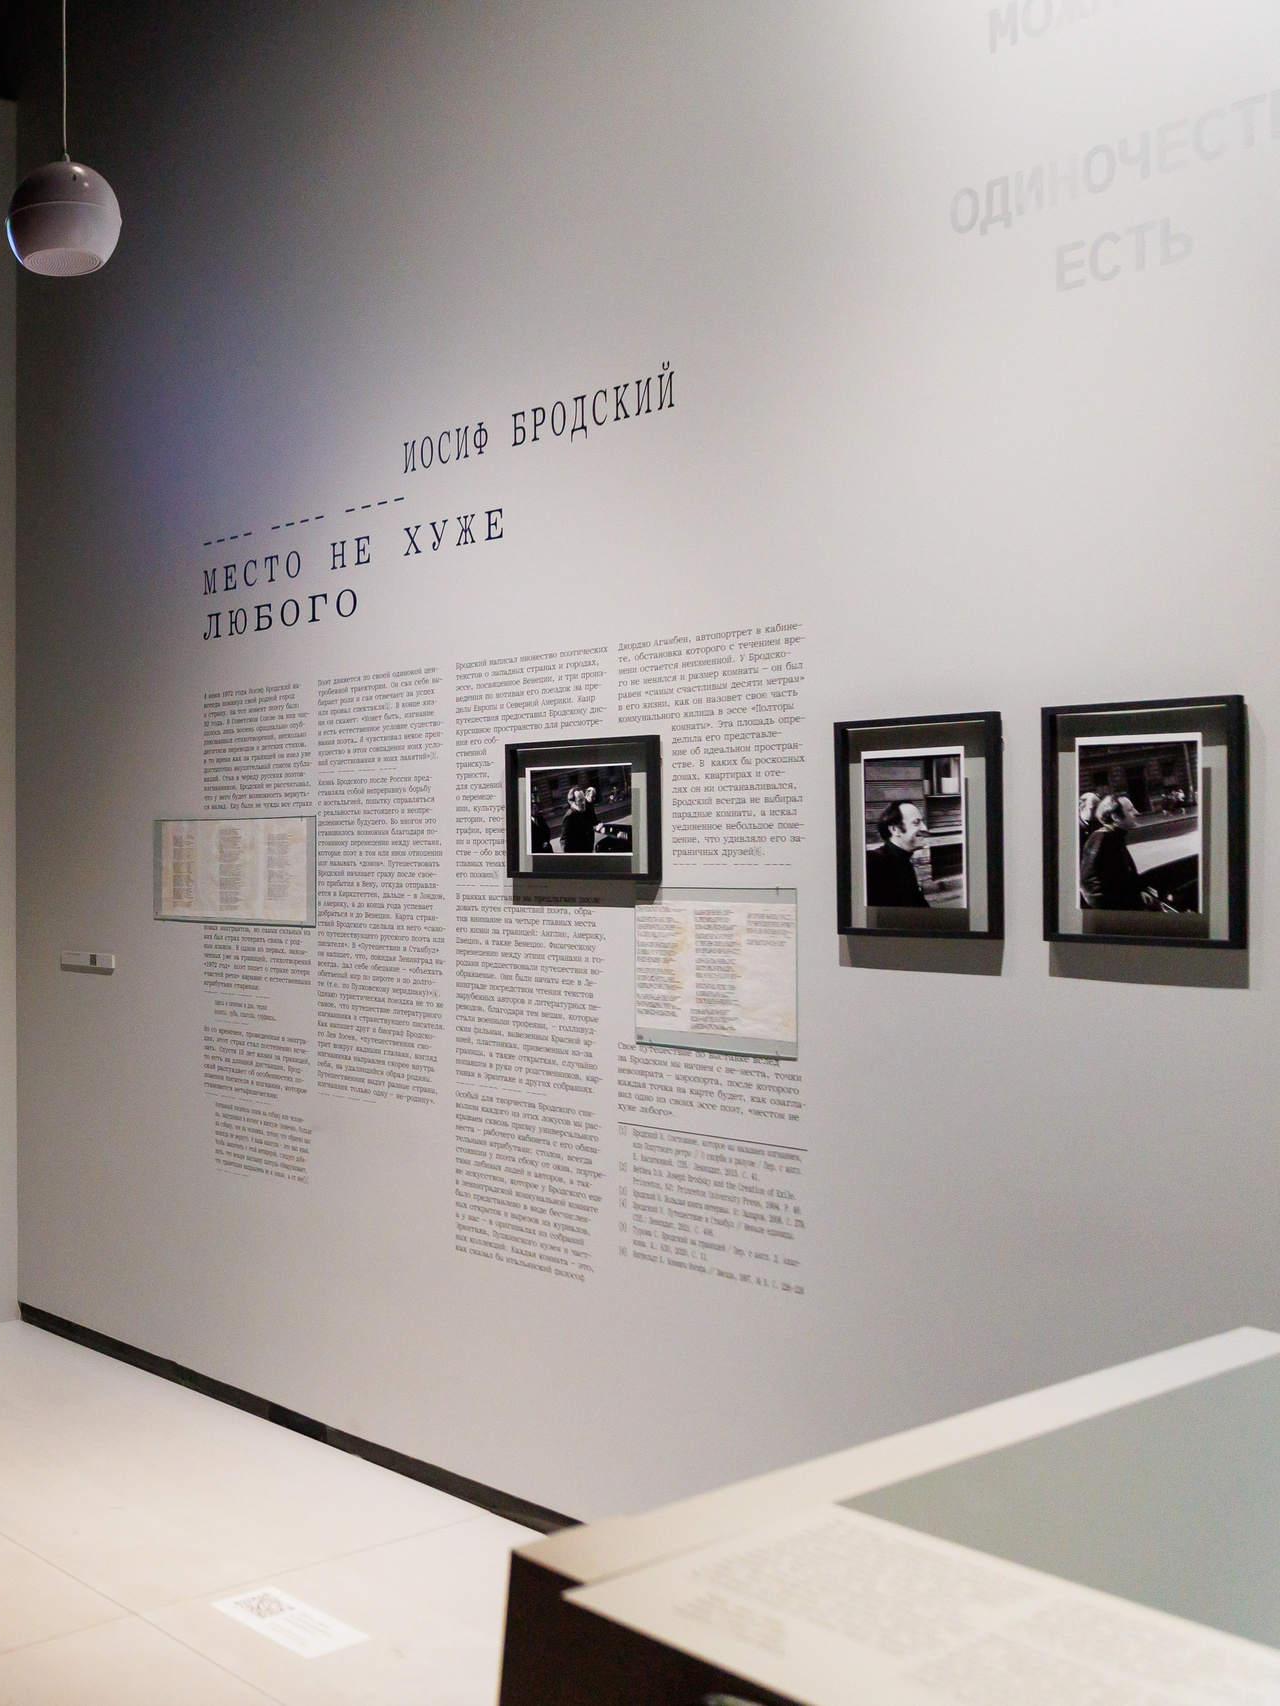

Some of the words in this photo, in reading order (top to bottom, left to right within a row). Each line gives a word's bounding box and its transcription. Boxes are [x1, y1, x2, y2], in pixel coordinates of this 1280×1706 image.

[1056, 217, 1194, 293] ЕСТЬ
[403, 422, 490, 474] ИОСИФ
[512, 361, 676, 447] БРОДСКИЙ
[203, 551, 303, 596] МЕСТО
[331, 536, 372, 571] НЕ
[403, 508, 505, 556] ХУЖЕ
[203, 589, 359, 641] ЛЮБОГО
[618, 641, 651, 651] Джорджо
[654, 636, 691, 647] Агамбен,
[696, 629, 752, 642] автопортрет
[765, 623, 802, 633] кабине-
[635, 650, 682, 661] обстановка
[686, 644, 726, 656] которого
[738, 639, 780, 649] течением
[784, 636, 805, 646] вре-
[619, 667, 637, 675] мени
[640, 662, 678, 672] остается
[682, 655, 736, 669] неизменной.
[749, 651, 791, 663] Бродско-
[643, 674, 676, 684] менялся
[688, 670, 719, 682] размер
[722, 667, 759, 677] комнаты
[786, 662, 802, 670] был
[618, 690, 641, 700] равен
[645, 687, 673, 697] «самым
[677, 683, 727, 694] счастливым
[731, 680, 763, 690] десяти
[766, 676, 804, 688] метрам»
[626, 702, 640, 710] его
[643, 700, 669, 709] жизни,
[674, 699, 689, 707] как
[706, 694, 742, 703] назовет
[746, 692, 767, 701] свою
[771, 689, 798, 698] часть
[672, 736, 702, 745] делила
[706, 734, 720, 742] его
[724, 731, 781, 742] представле-
[704, 745, 750, 755] идеальном
[755, 743, 803, 752] простран-
[711, 759, 737, 767] каких
[755, 755, 805, 766] роскошных
[672, 797, 712, 807] Бродский
[716, 797, 746, 805] всегда
[764, 795, 803, 804] выбирал
